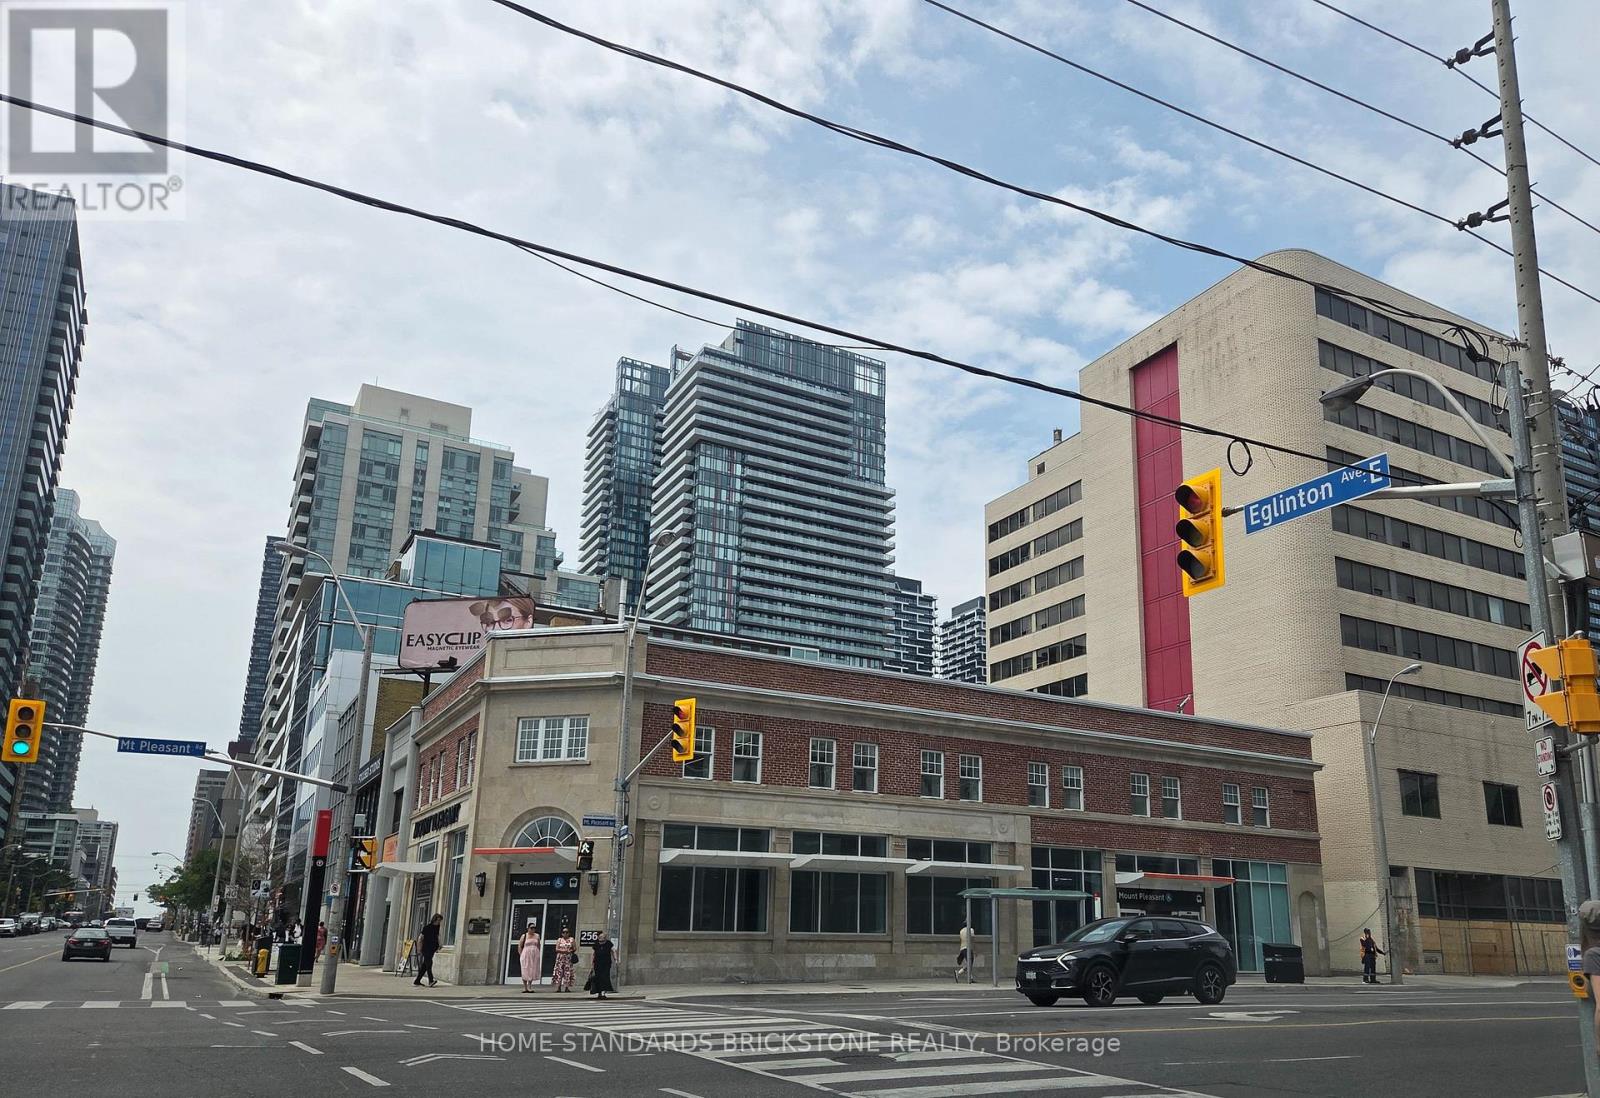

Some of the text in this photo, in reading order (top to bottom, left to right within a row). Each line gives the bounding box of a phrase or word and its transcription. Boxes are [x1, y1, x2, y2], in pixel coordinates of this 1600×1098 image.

[1249, 482, 1333, 527] Eglinton
[1369, 459, 1383, 483] E
[406, 631, 482, 647] EASYCLIP
[120, 739, 135, 750] Mt
[140, 741, 191, 753] Pleasant
[1118, 891, 1165, 901] Mount Pleasant
[581, 931, 598, 941] 256
